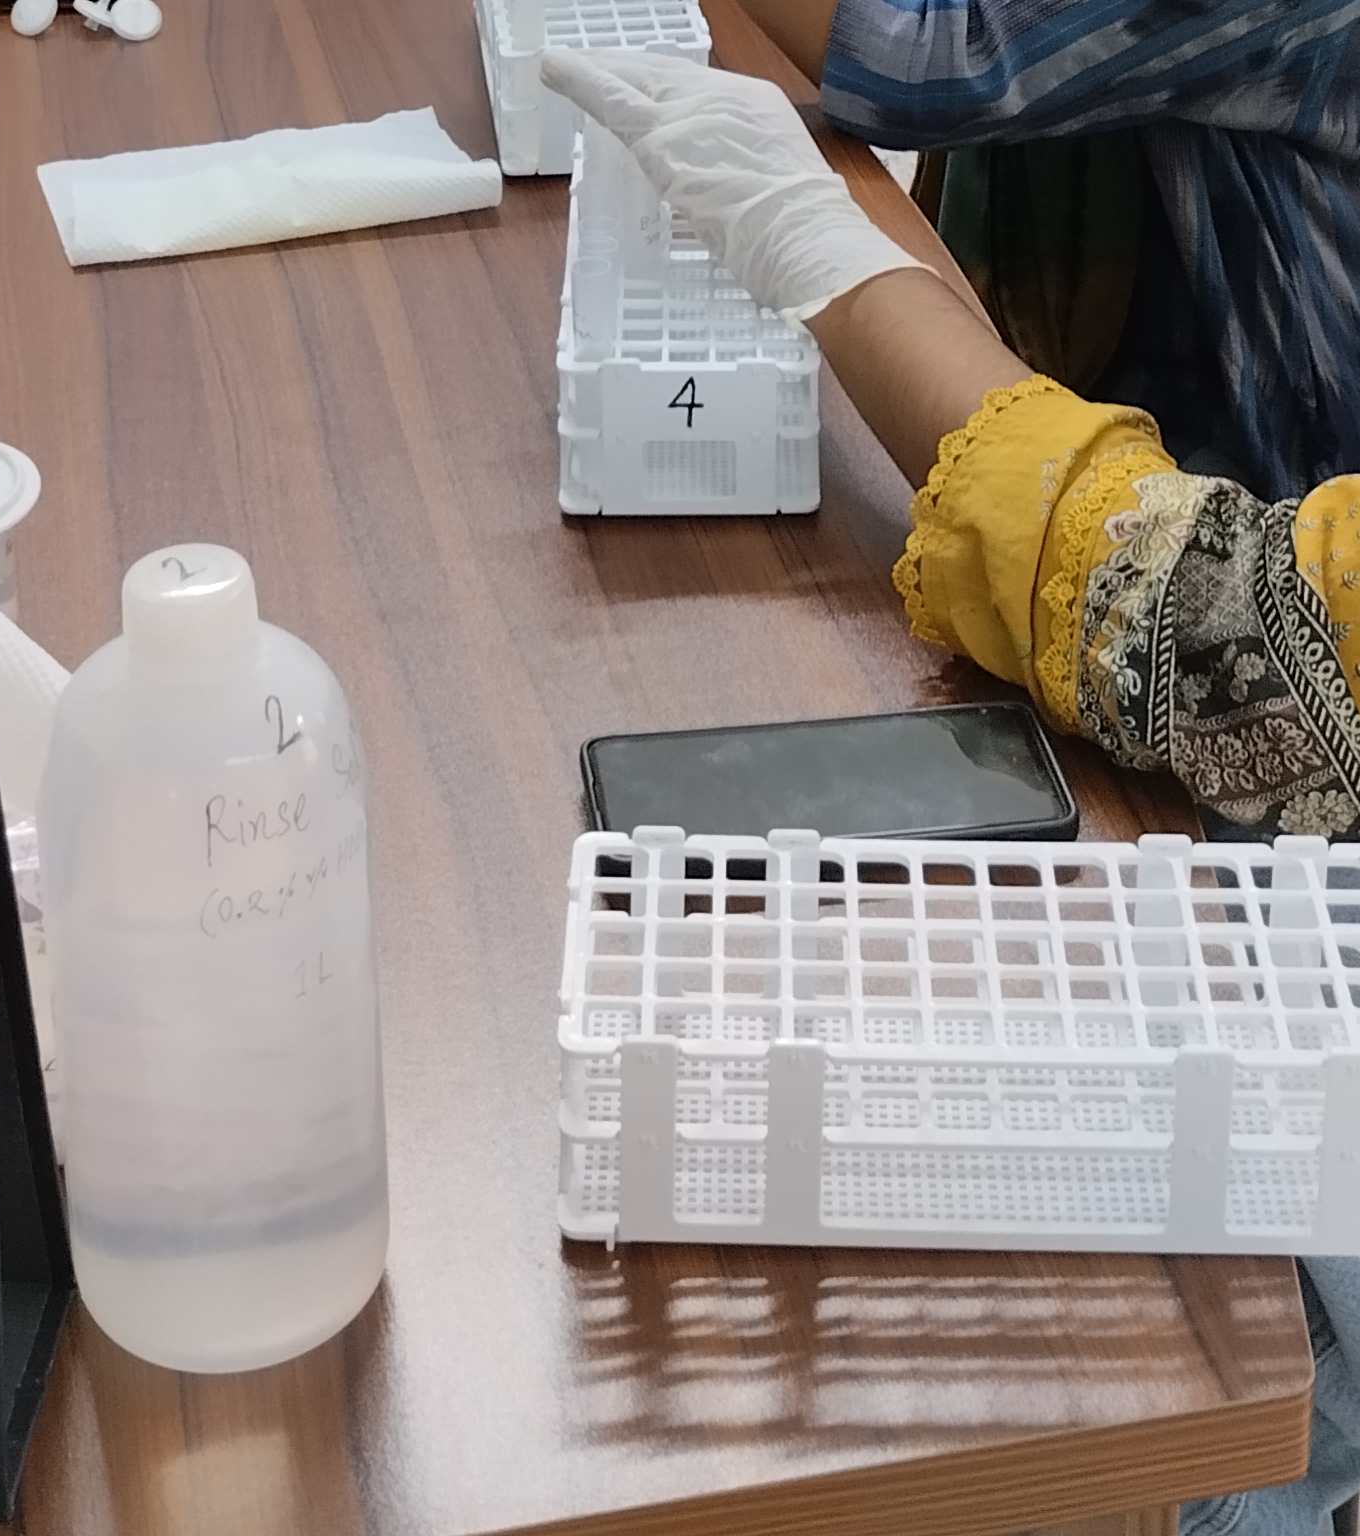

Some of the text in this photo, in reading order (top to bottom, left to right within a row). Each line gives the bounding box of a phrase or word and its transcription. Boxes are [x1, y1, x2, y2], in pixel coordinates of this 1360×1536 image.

[667, 376, 704, 428] 4
[161, 556, 208, 582] 2
[265, 695, 302, 754] 2
[206, 793, 310, 867] Rinse
